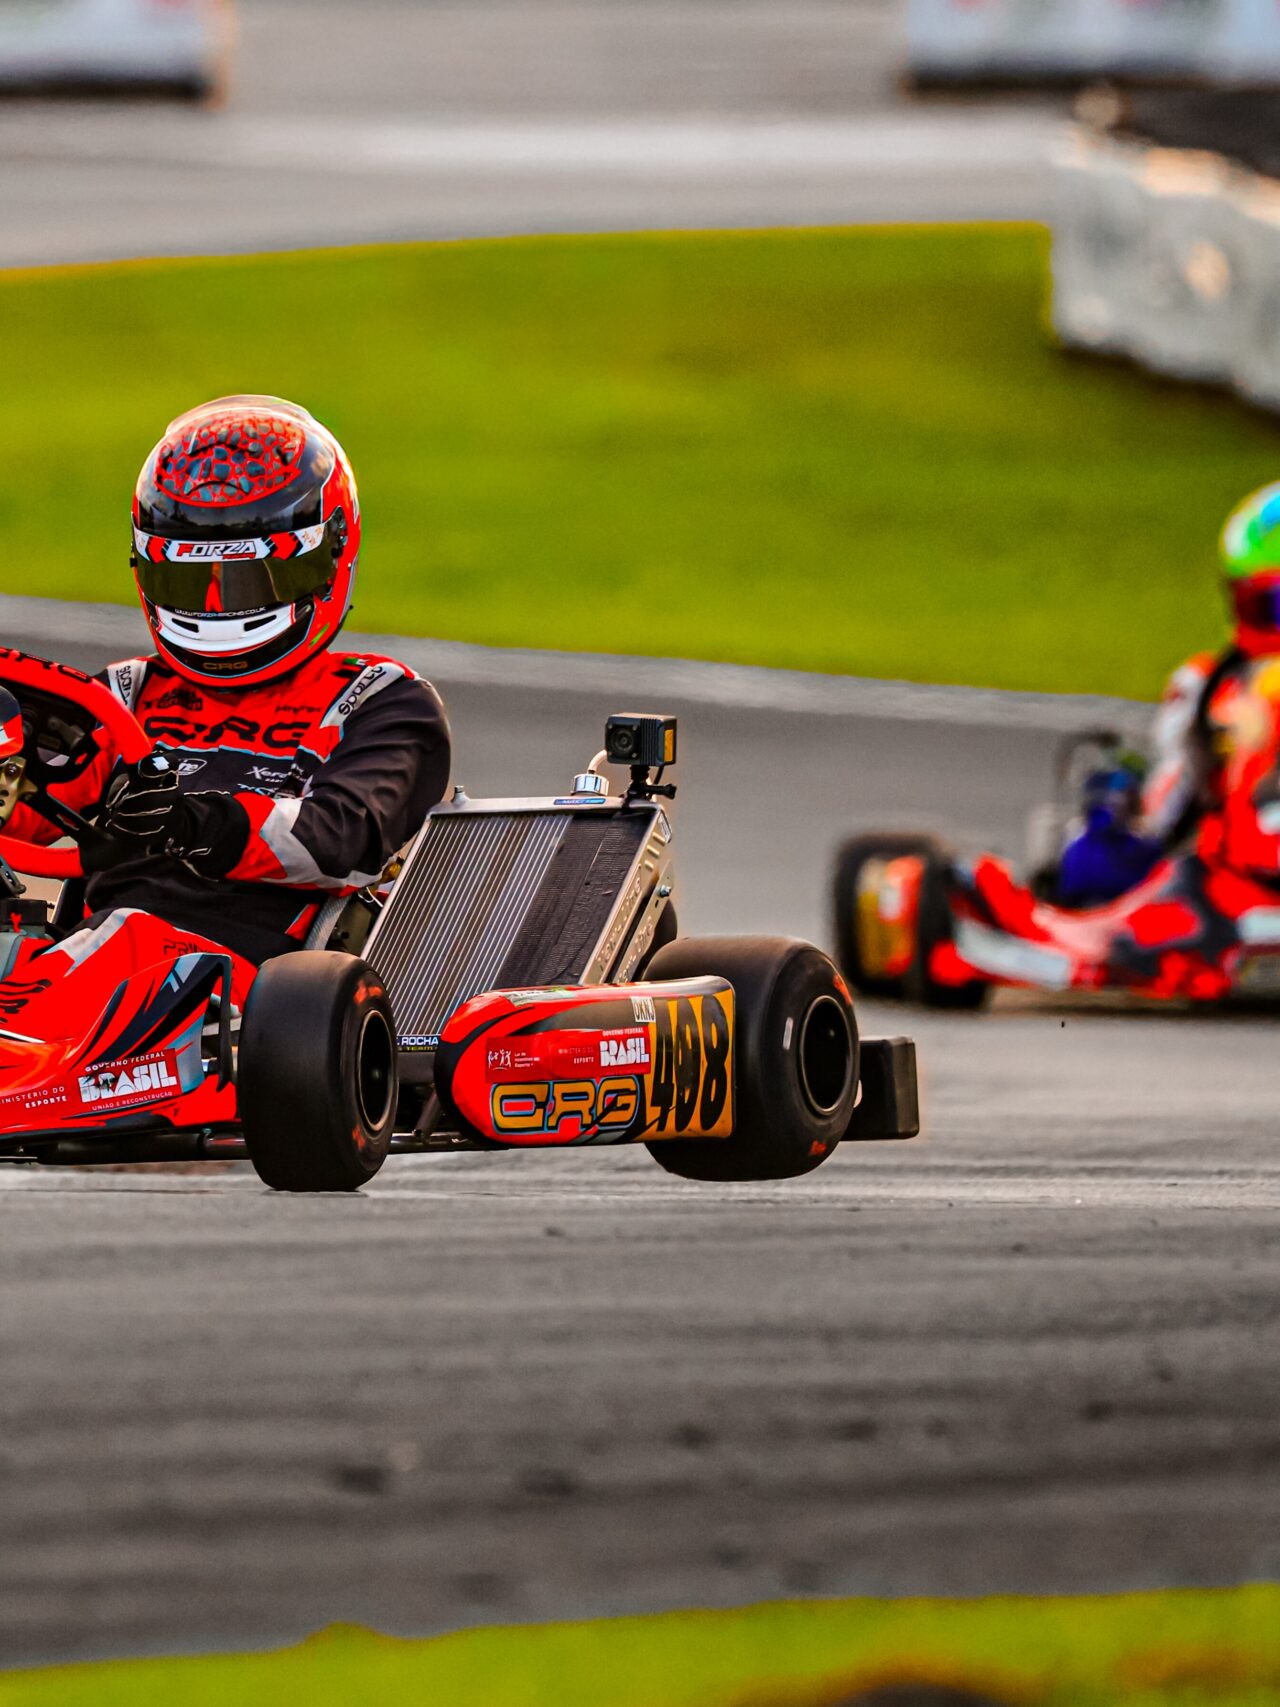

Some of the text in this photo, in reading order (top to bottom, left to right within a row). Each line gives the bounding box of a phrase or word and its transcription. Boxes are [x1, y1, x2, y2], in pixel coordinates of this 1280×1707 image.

[176, 541, 256, 557] FORZA
[202, 661, 248, 670] CRG
[401, 1036, 439, 1046] ROCHA
[600, 1037, 650, 1067] BRASIL
[85, 1051, 165, 1072] GOVERNO FEDERAL
[78, 1060, 177, 1103] BRASIL
[52, 1086, 65, 1094] DO
[25, 1095, 67, 1108] ESPORTE
[492, 1075, 638, 1132] CRG
